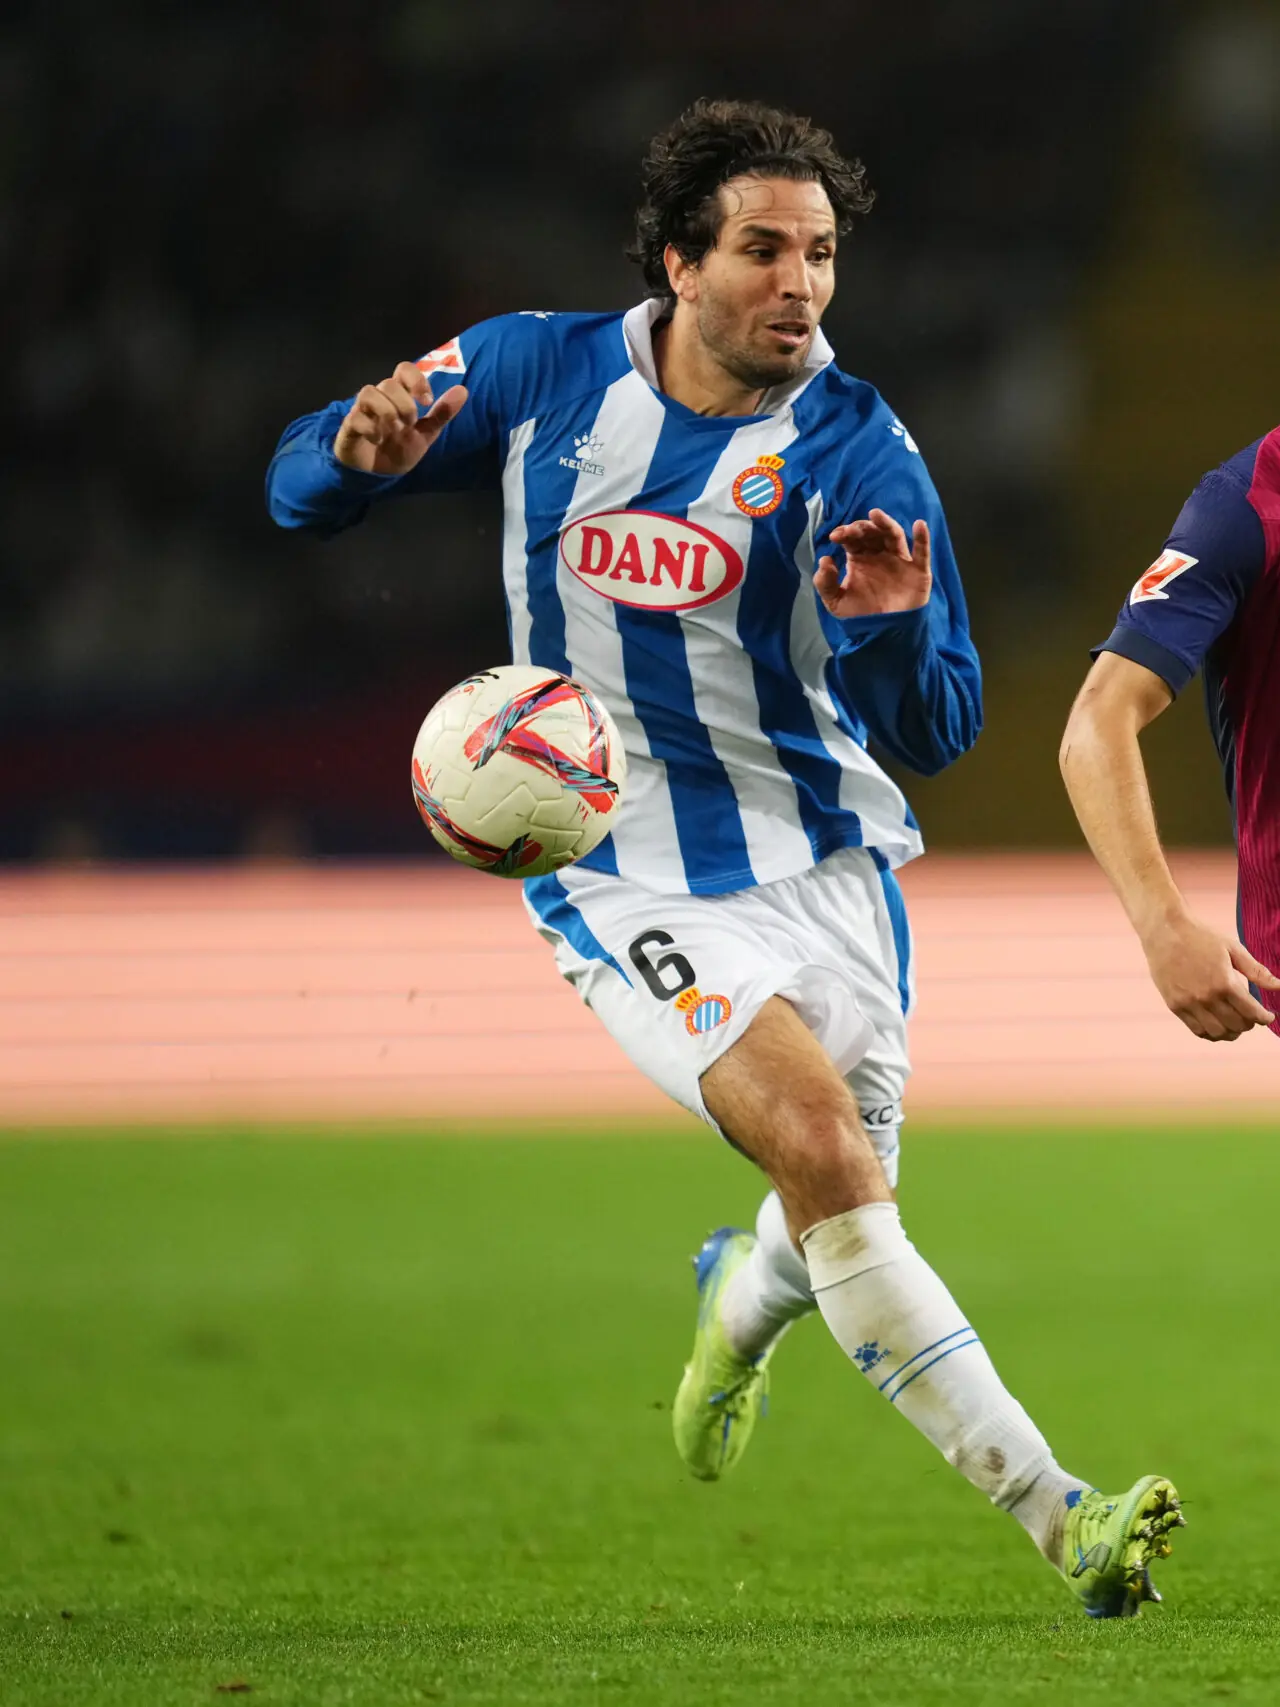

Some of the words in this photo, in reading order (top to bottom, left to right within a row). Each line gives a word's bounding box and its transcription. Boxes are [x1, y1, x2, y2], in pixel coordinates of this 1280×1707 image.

[559, 456, 605, 476] KELME
[577, 526, 710, 592] DANI
[628, 929, 697, 1001] 6
